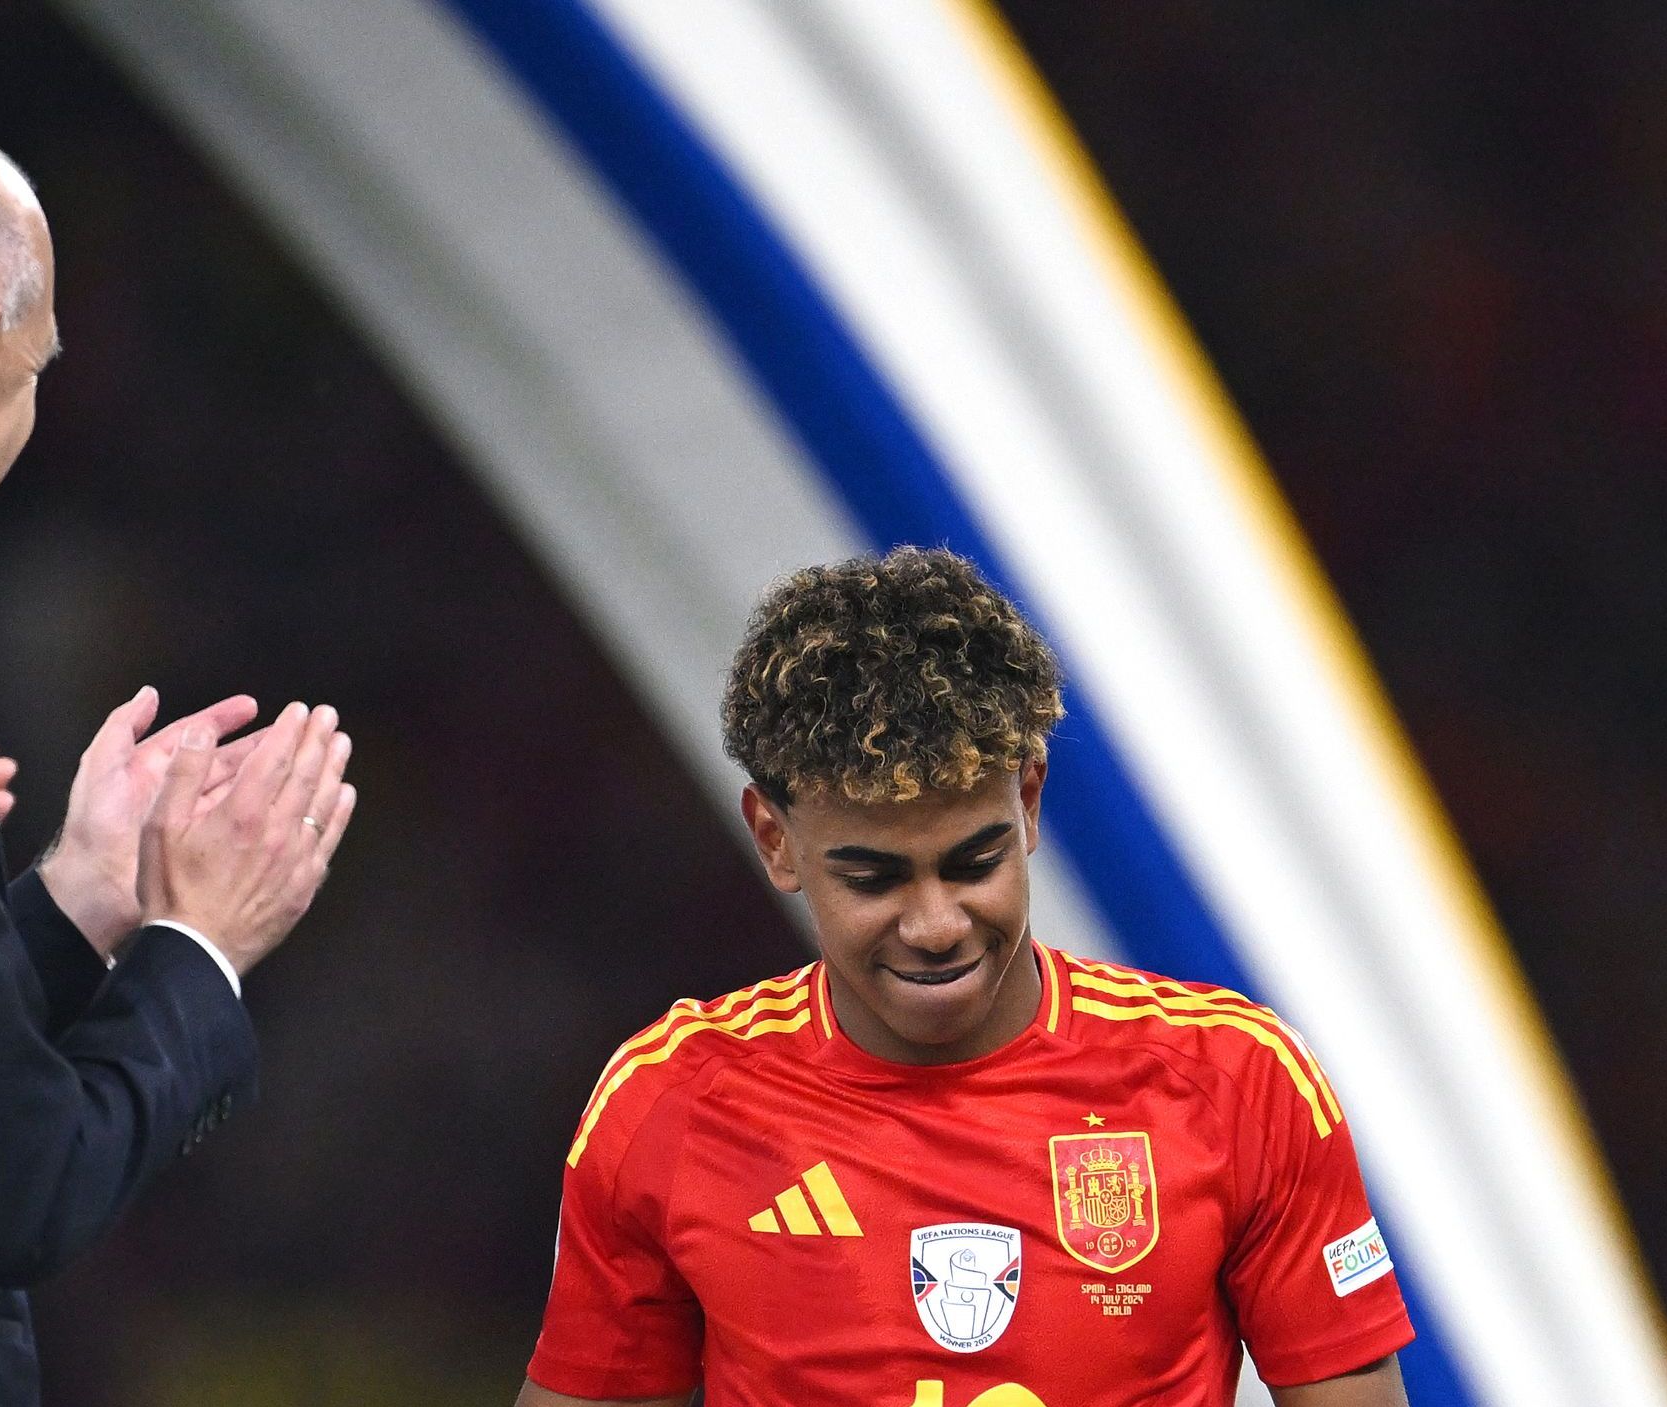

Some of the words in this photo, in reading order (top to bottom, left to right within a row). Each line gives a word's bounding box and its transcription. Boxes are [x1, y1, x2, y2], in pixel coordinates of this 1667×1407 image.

[917, 1231, 939, 1241] UEFA
[940, 1227, 979, 1236] NATIONS
[981, 1229, 1015, 1241] LEAGUE
[1328, 1239, 1356, 1260] UEFA
[1081, 1284, 1106, 1294] SPAIN
[1115, 1284, 1152, 1294] ENGLAND
[1090, 1295, 1100, 1304] 14
[1101, 1295, 1121, 1304] JULY
[1122, 1295, 1144, 1304] 2024
[1103, 1306, 1132, 1316] BERLIN
[939, 1333, 972, 1349] WINNER
[974, 1333, 993, 1347] 2023
